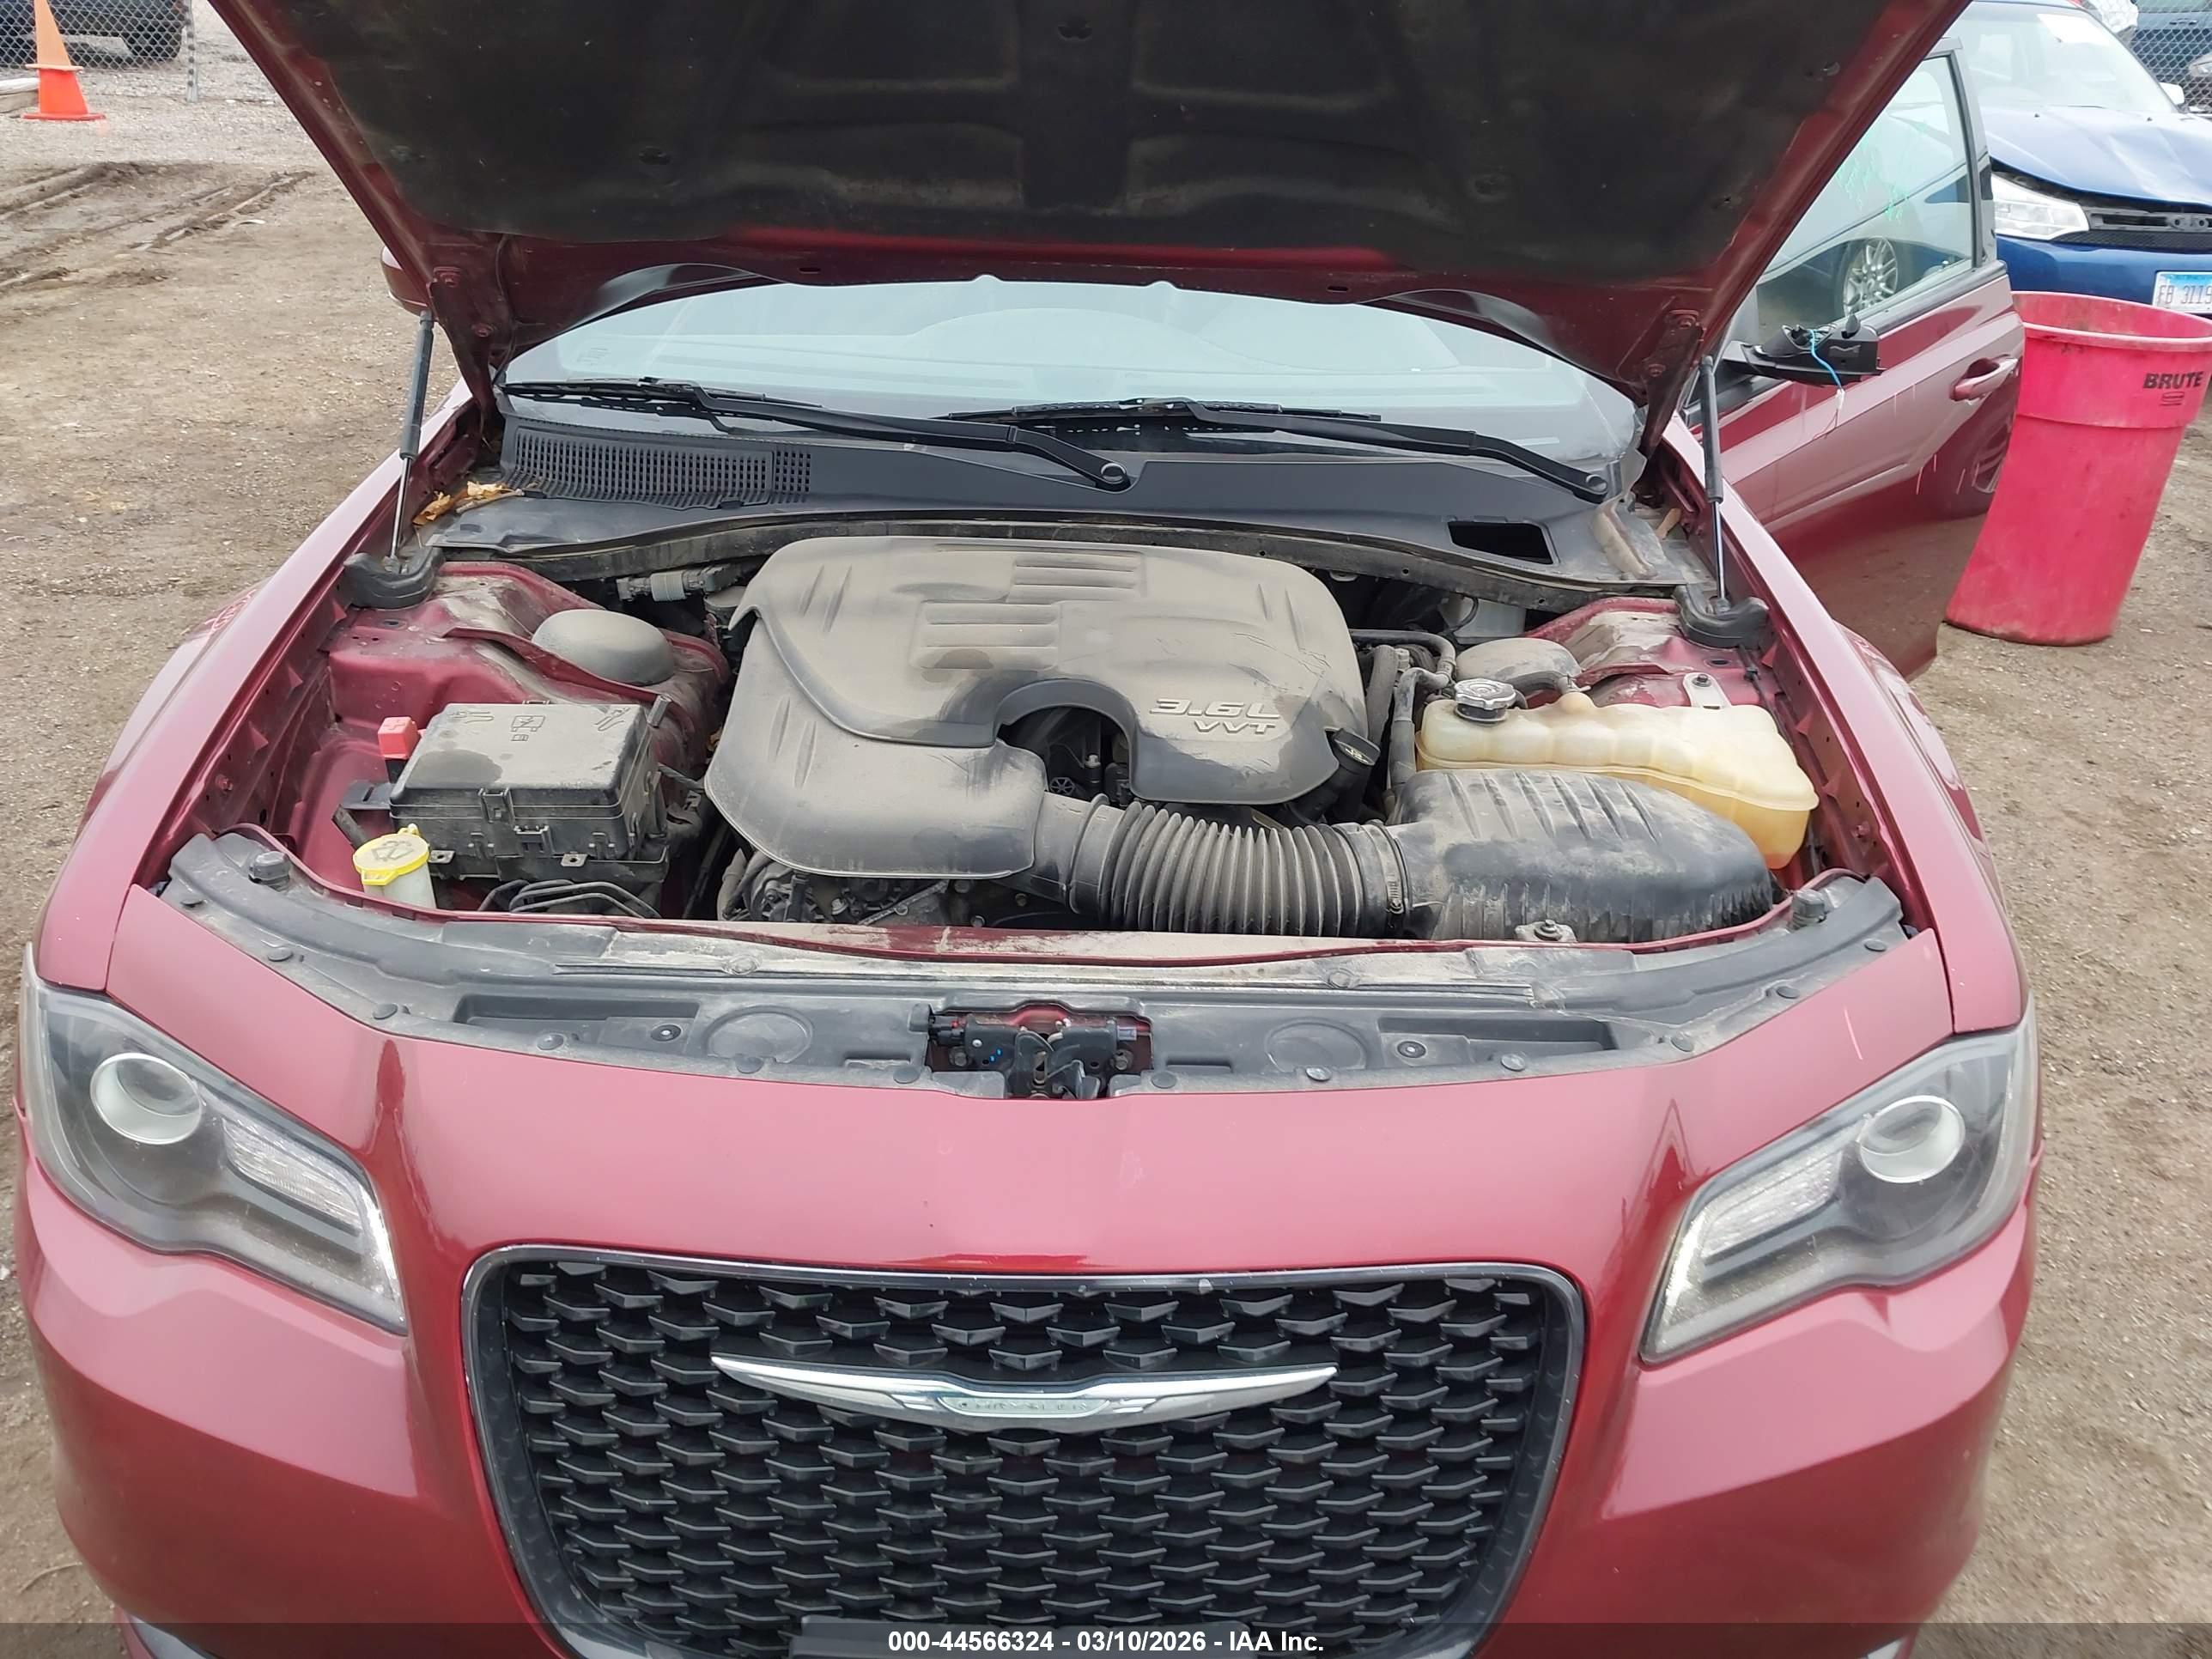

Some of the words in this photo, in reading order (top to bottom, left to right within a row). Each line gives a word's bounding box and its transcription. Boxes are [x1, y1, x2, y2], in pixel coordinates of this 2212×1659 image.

[2142, 371, 2204, 389] BRUTE
[1150, 698, 1281, 720] 3.6L
[1194, 720, 1276, 734] VVT
